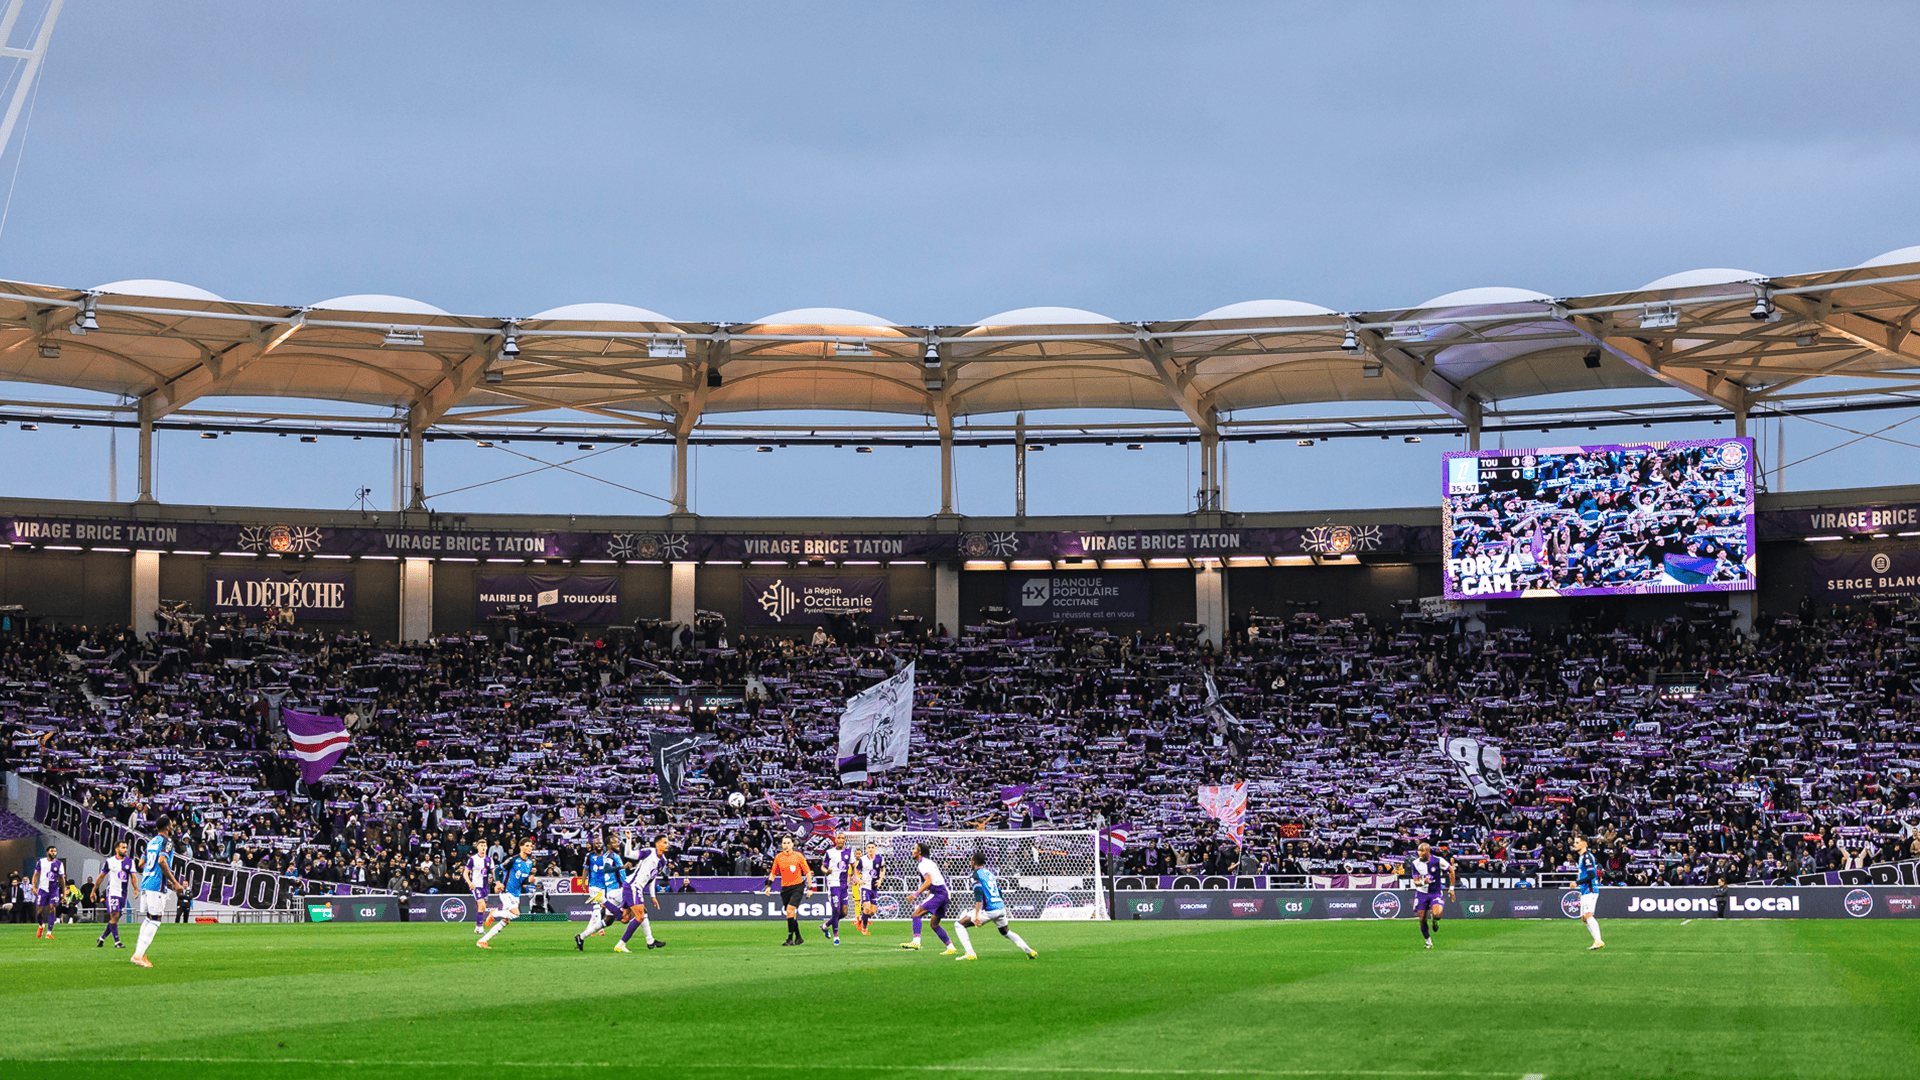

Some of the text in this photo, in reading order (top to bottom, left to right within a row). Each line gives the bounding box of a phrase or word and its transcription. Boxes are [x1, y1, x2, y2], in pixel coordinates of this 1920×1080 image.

[1481, 457, 1520, 467] TOU 0
[1481, 470, 1520, 479] AJA 0
[1811, 509, 1917, 529] VIRAGE BRICE
[14, 521, 177, 543] VIRAGE BRICE TATON
[385, 534, 546, 552] VIRAGE BRICE TATON
[744, 539, 903, 554] VIRAGE BRICE TATON
[1081, 533, 1240, 551] VIRAGE BRICE TATON
[1447, 553, 1522, 578] FORZA
[1053, 578, 1102, 587] BANQUE
[1462, 573, 1512, 596] CAM
[1827, 578, 1873, 590] SERGE
[814, 587, 841, 595] Région
[1053, 587, 1119, 596] POPULAIRE
[480, 592, 617, 604] MAIRIE DE TOULOUSE
[804, 595, 873, 607] Occitanie
[1053, 598, 1099, 606] OCCITANE
[1669, 685, 1697, 694] SORTIE
[43, 795, 83, 842] PER
[674, 901, 763, 917] Jouons
[1136, 903, 1154, 912] CBS
[1285, 902, 1302, 911] CBS
[1468, 904, 1485, 913] CBS
[1627, 895, 1800, 912] Jouons Local
[360, 908, 376, 917] CBS
